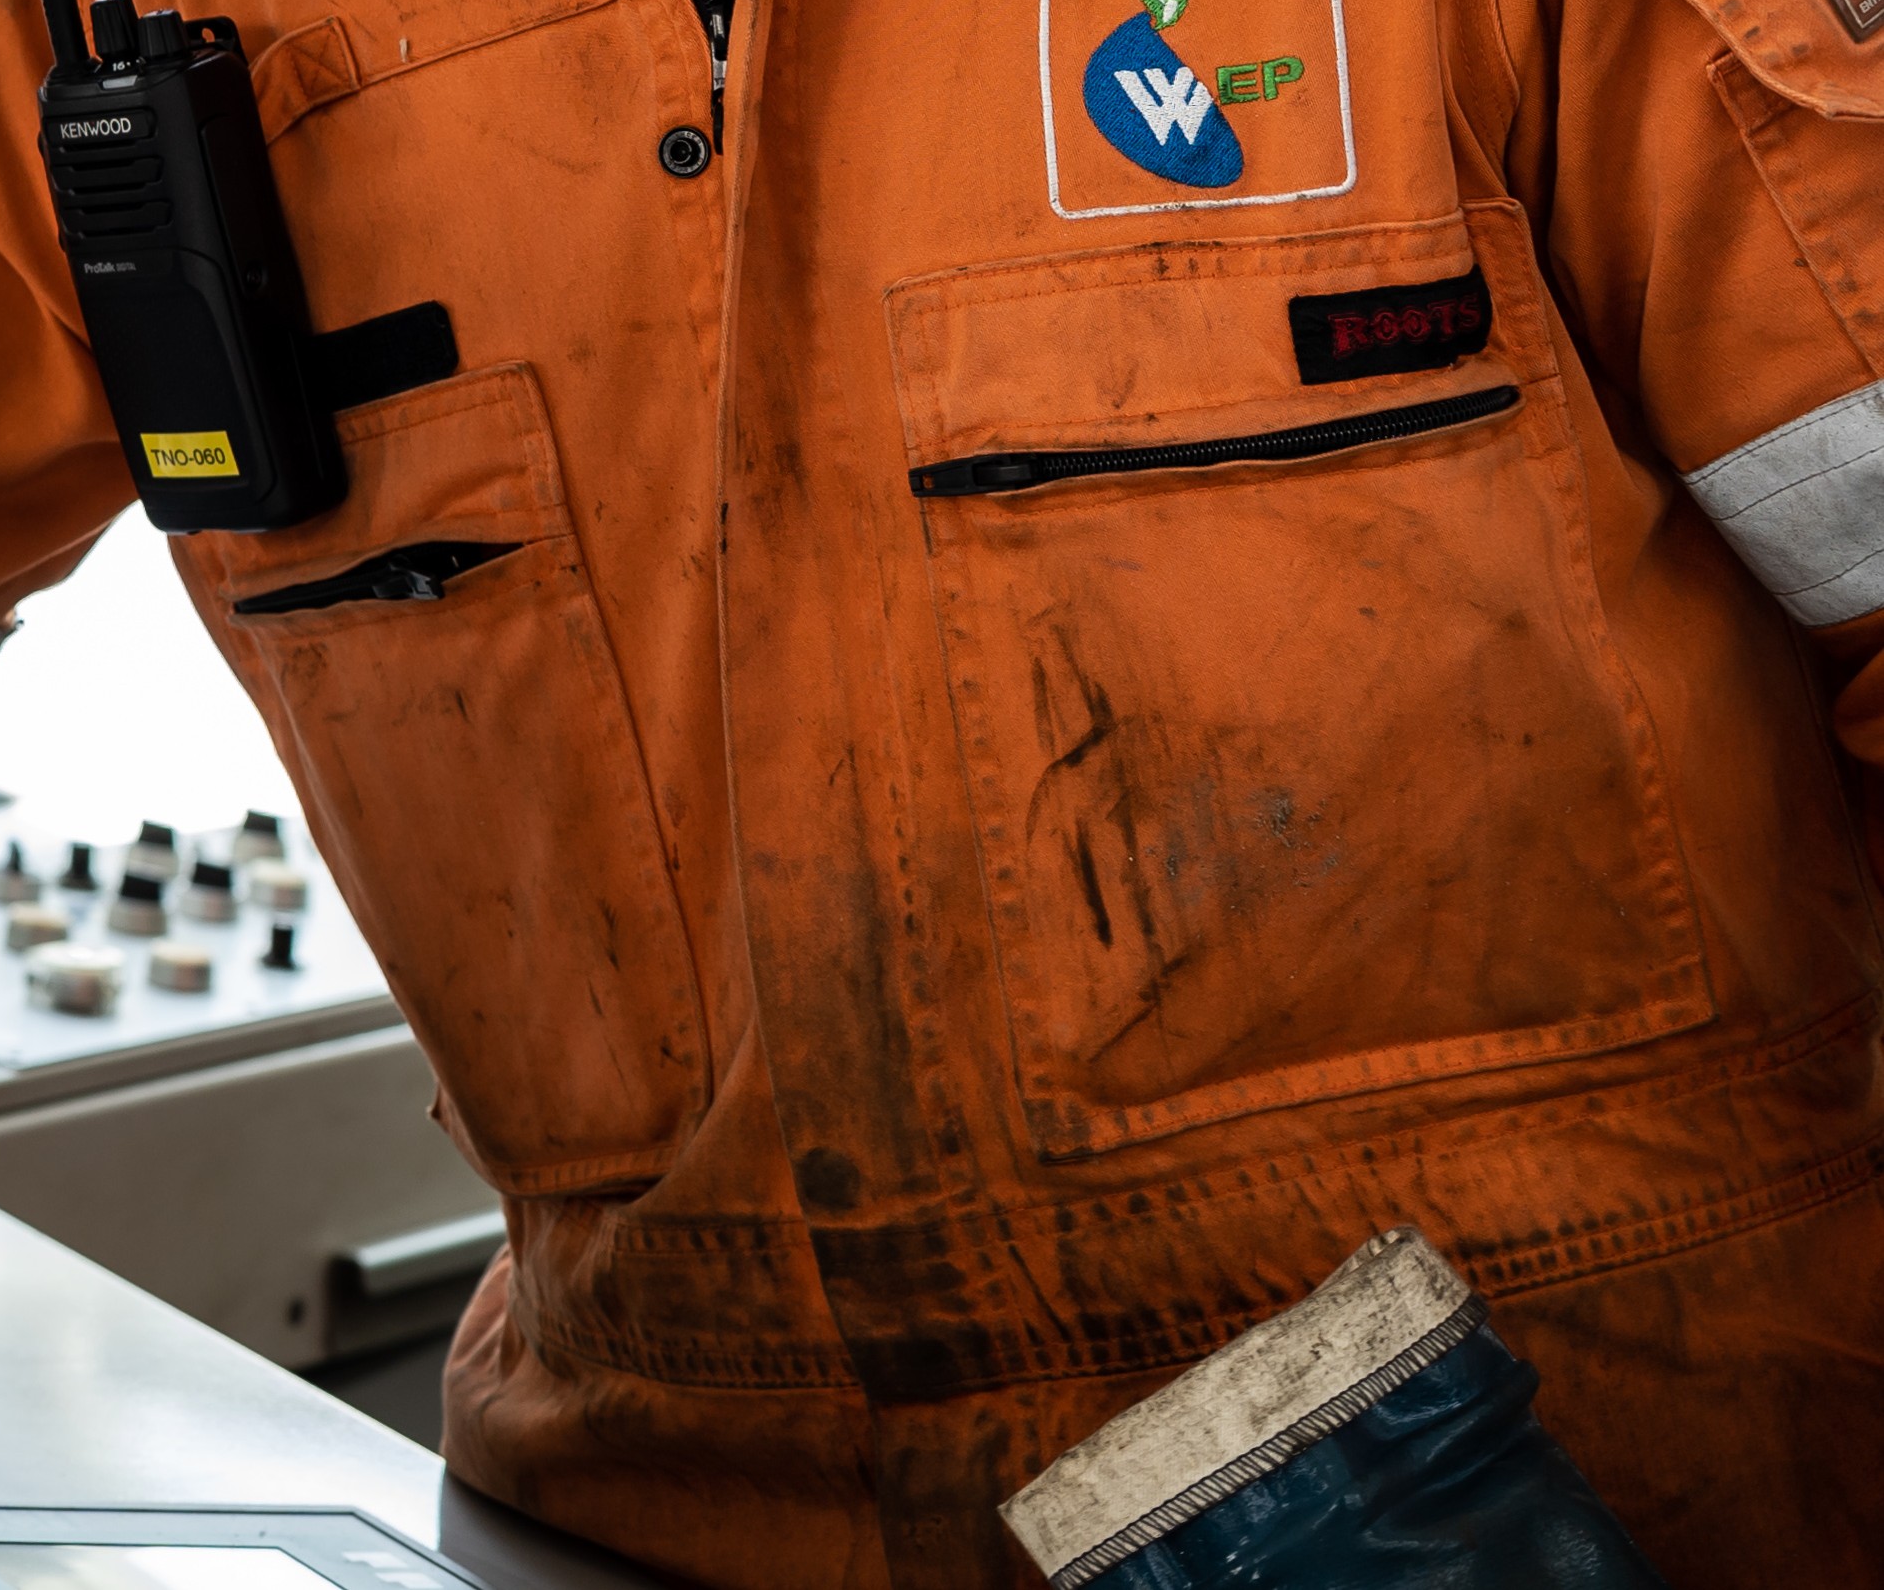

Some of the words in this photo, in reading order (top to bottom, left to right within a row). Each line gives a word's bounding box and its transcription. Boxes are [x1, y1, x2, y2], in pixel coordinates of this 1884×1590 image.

[60, 117, 132, 139] KENWOOD
[1328, 293, 1481, 360] ROOTS
[150, 447, 226, 466] TNO-060
